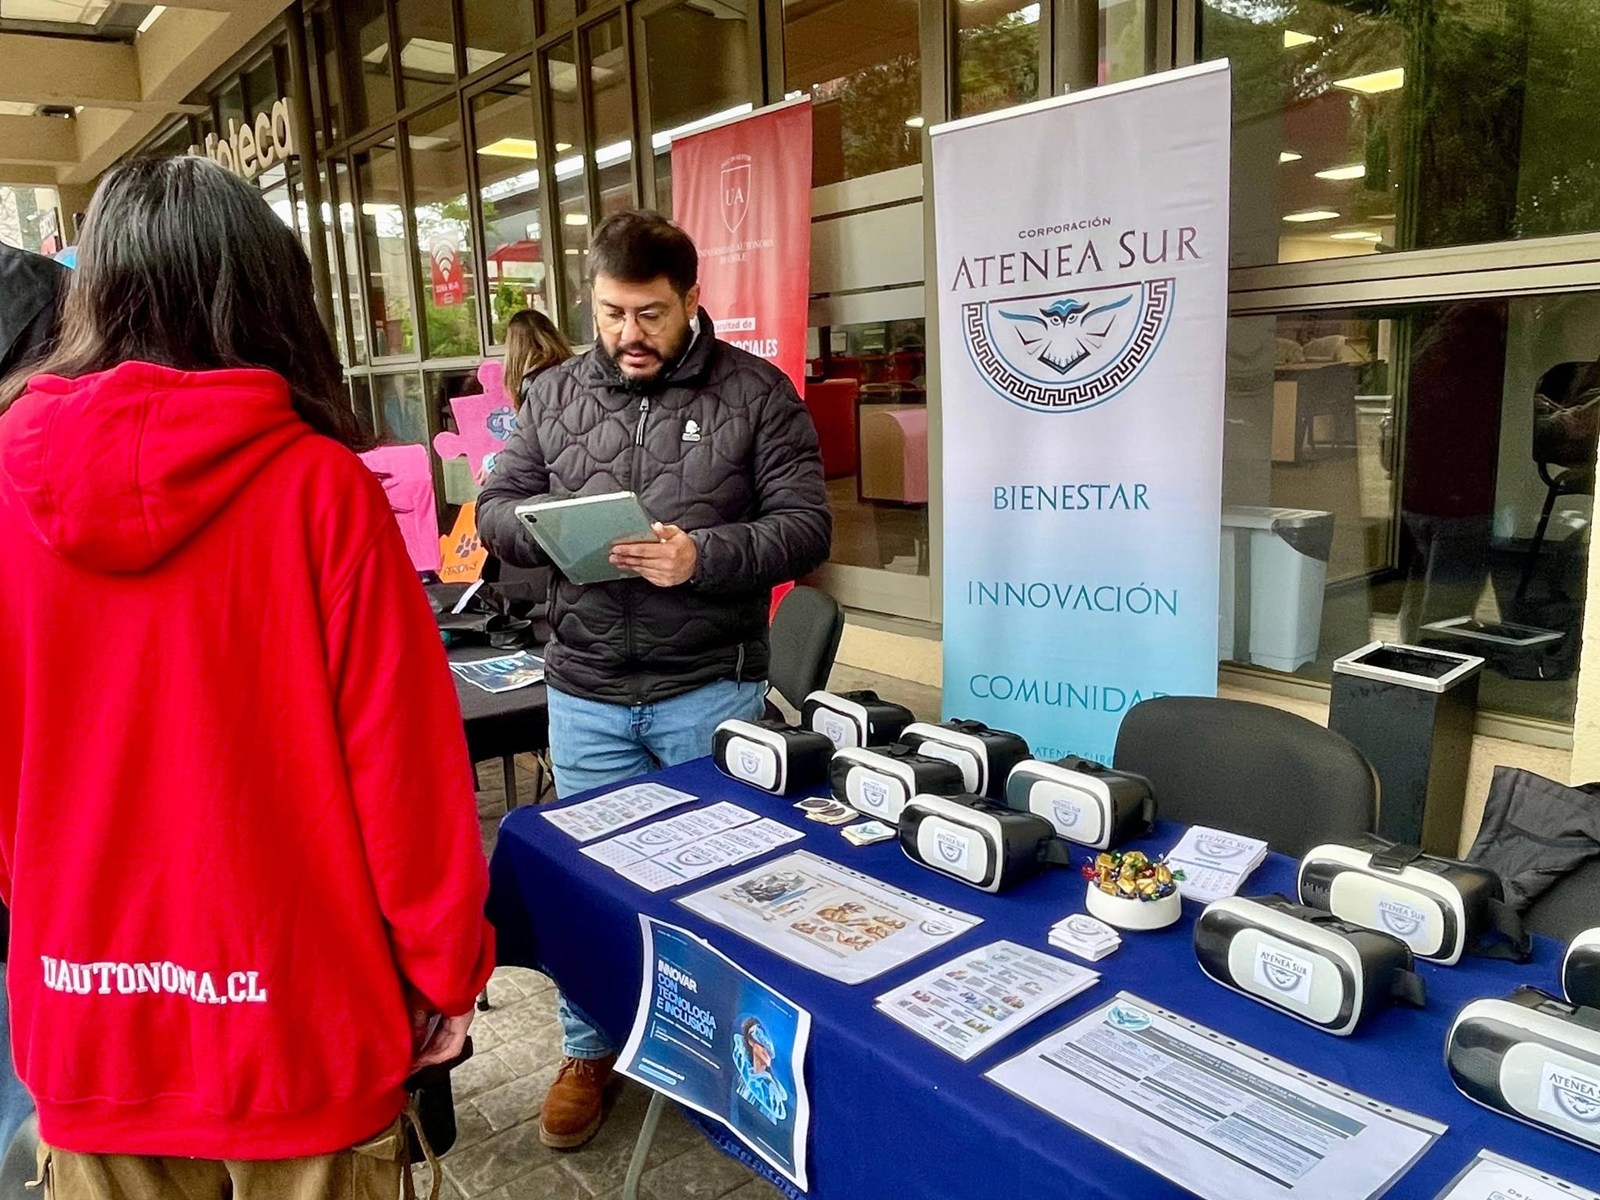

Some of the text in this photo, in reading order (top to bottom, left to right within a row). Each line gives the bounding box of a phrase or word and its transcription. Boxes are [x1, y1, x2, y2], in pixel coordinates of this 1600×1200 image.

[1018, 217, 1111, 239] CORPORACIÓN
[951, 226, 1202, 292] ATENEA SUR
[716, 321, 740, 330] acultad
[993, 483, 1150, 511] BIENESTAR
[968, 581, 1178, 616] INNOVACIÓN
[970, 674, 1170, 713] COMUNIDA
[1378, 901, 1409, 916] ATENEA
[1411, 910, 1426, 921] SUR
[658, 959, 697, 993] INNOVAR
[1260, 951, 1290, 969] ATENEA
[1292, 963, 1307, 976] SUR
[41, 956, 267, 1004] UAUTONOMA.CL
[658, 973, 678, 993] CON
[656, 996, 664, 1009] E
[657, 984, 716, 1029] TECNOLOGÍA
[1549, 1073, 1595, 1096] ATENEA
